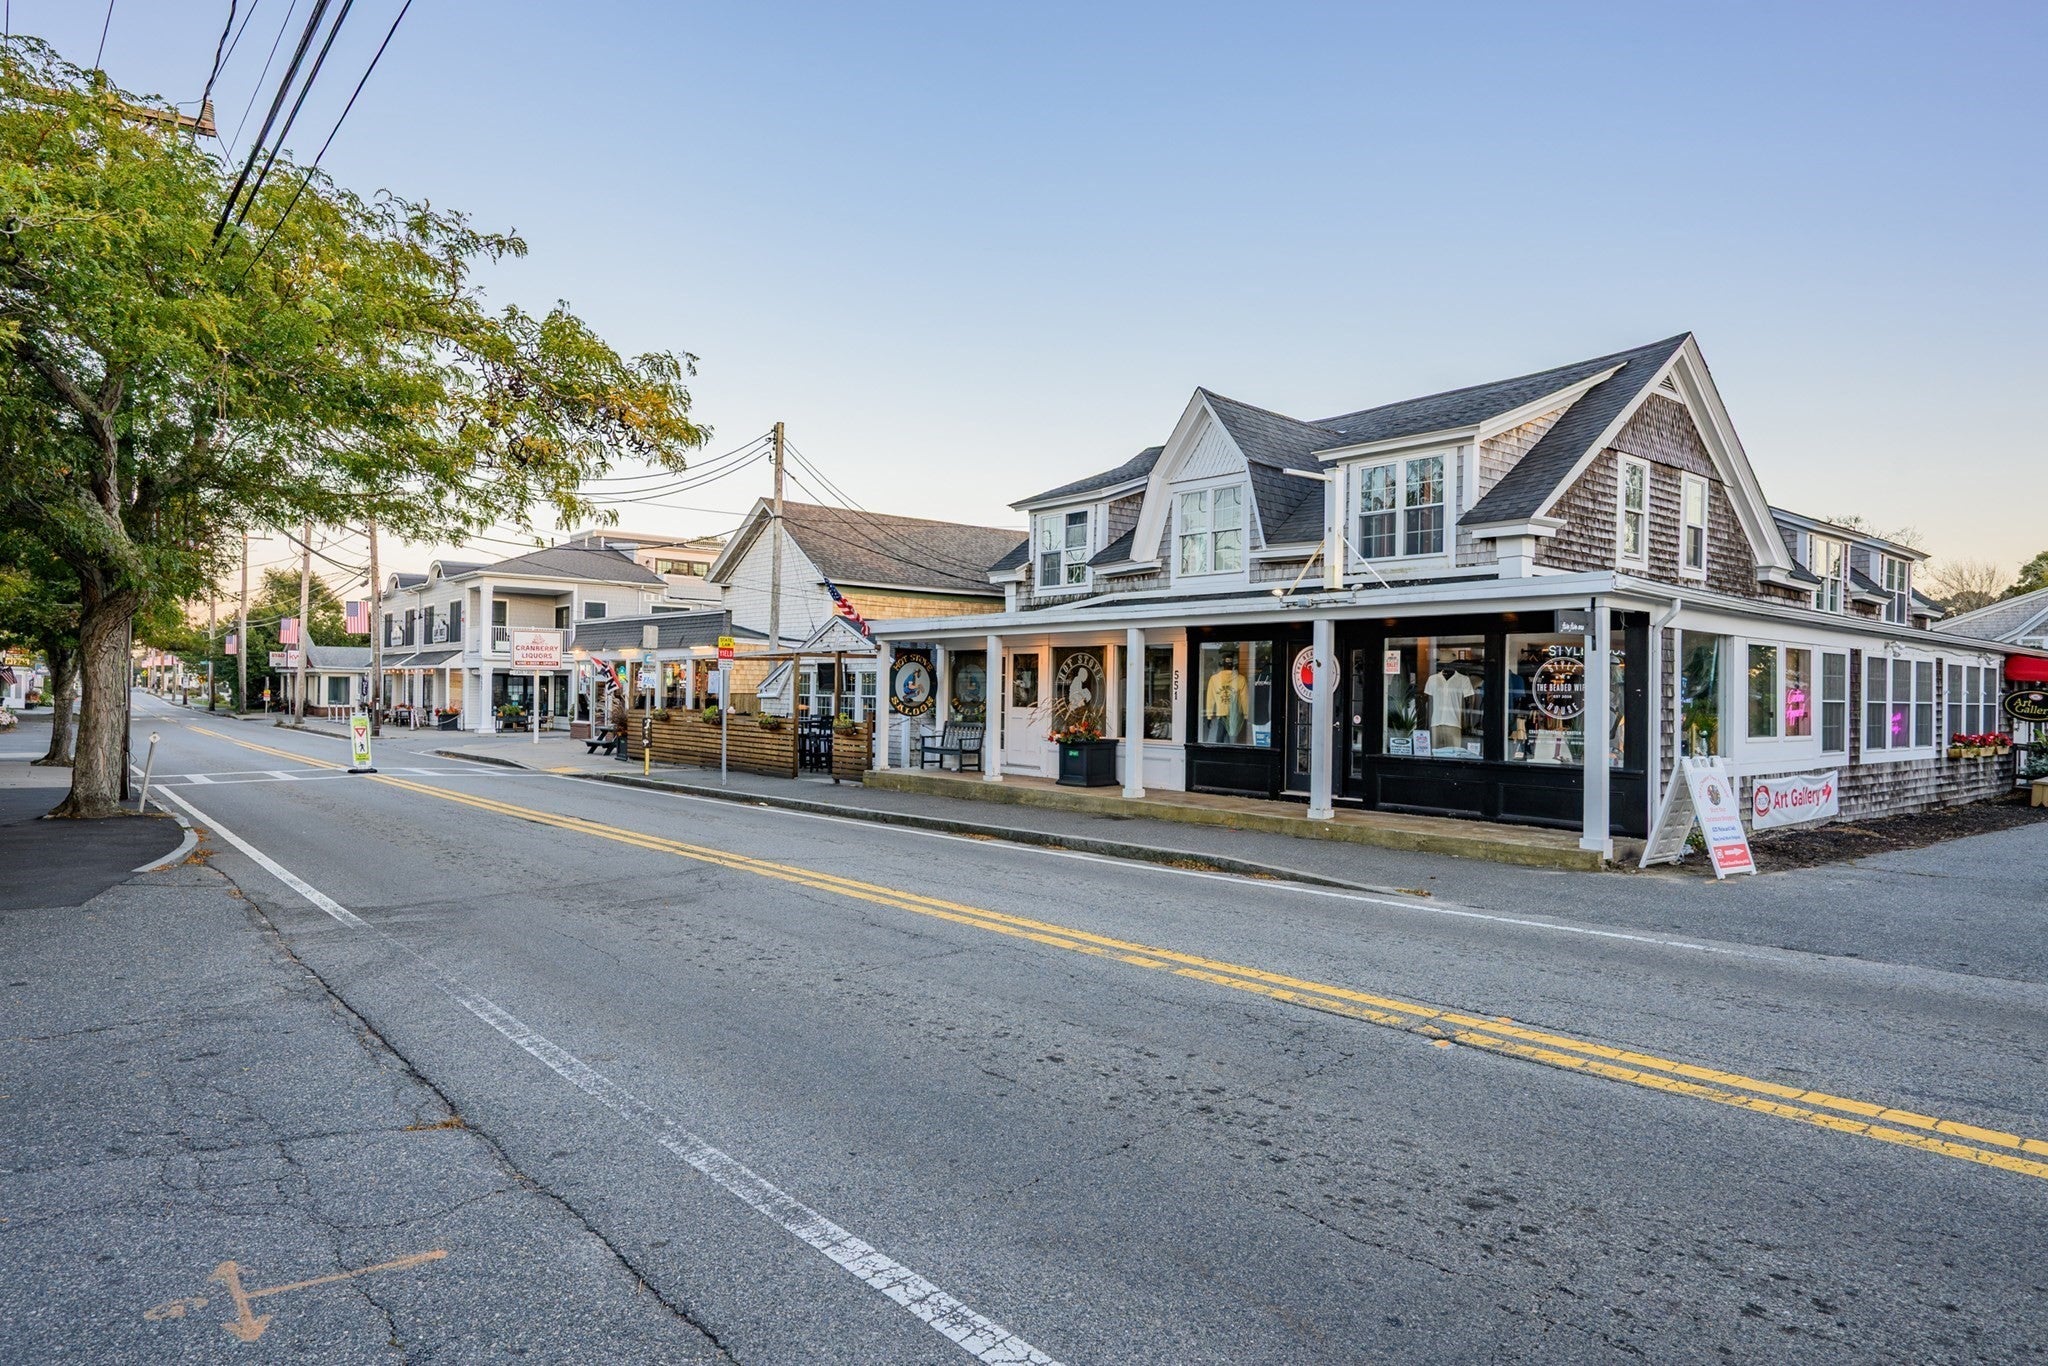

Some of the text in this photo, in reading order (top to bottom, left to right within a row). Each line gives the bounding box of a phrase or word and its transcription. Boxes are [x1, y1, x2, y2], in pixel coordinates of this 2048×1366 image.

[893, 653, 933, 672] HOT STOVE
[1058, 654, 1103, 681] HOT STOVE
[1547, 660, 1578, 673] STYLE
[1536, 683, 1547, 692] THE
[1549, 683, 1572, 692] BEADED
[891, 695, 934, 716] SALOON
[1546, 702, 1579, 715] HOUSE
[2013, 698, 2032, 707] Art
[2015, 705, 2048, 716] Galler
[1773, 791, 1789, 809] Art
[1790, 786, 1821, 807] Gallery
